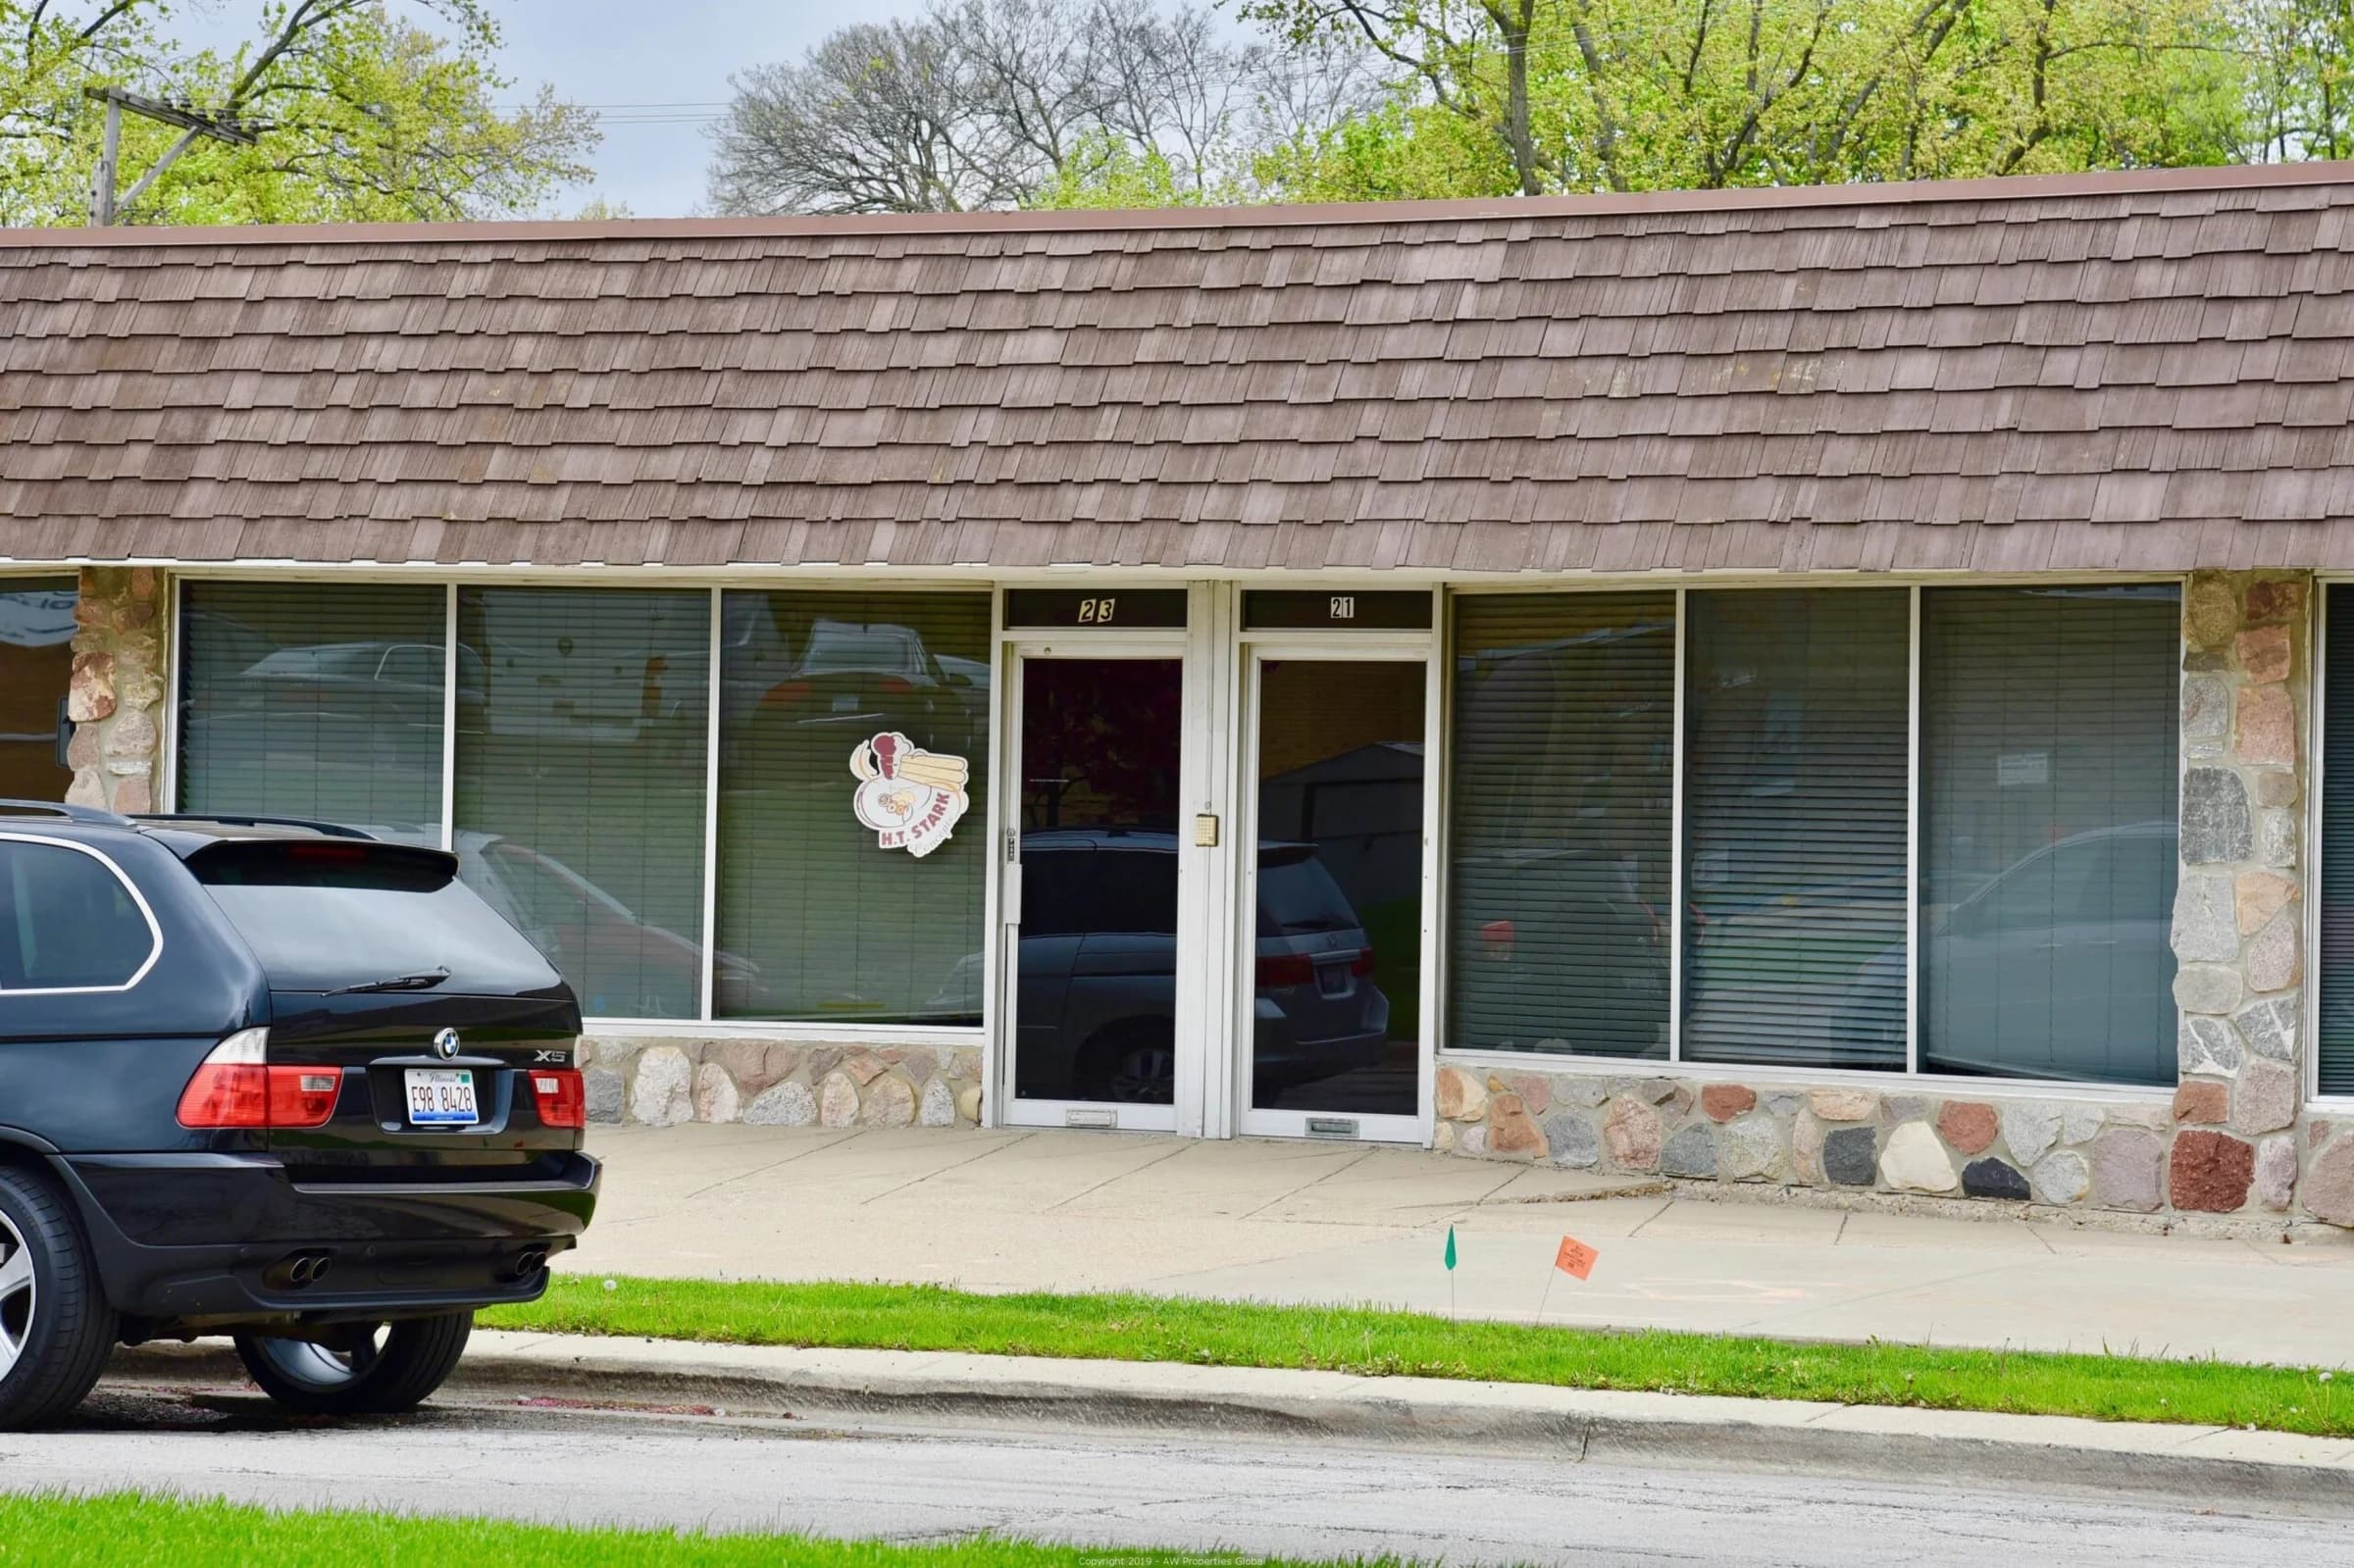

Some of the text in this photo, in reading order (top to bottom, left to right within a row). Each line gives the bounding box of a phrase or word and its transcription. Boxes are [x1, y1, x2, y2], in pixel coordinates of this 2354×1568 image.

[1079, 599, 1114, 622] 23
[1331, 597, 1354, 619] 21
[882, 792, 949, 846] H.T. STARK
[534, 1049, 566, 1063] X5
[411, 1087, 473, 1113] E98 8428
